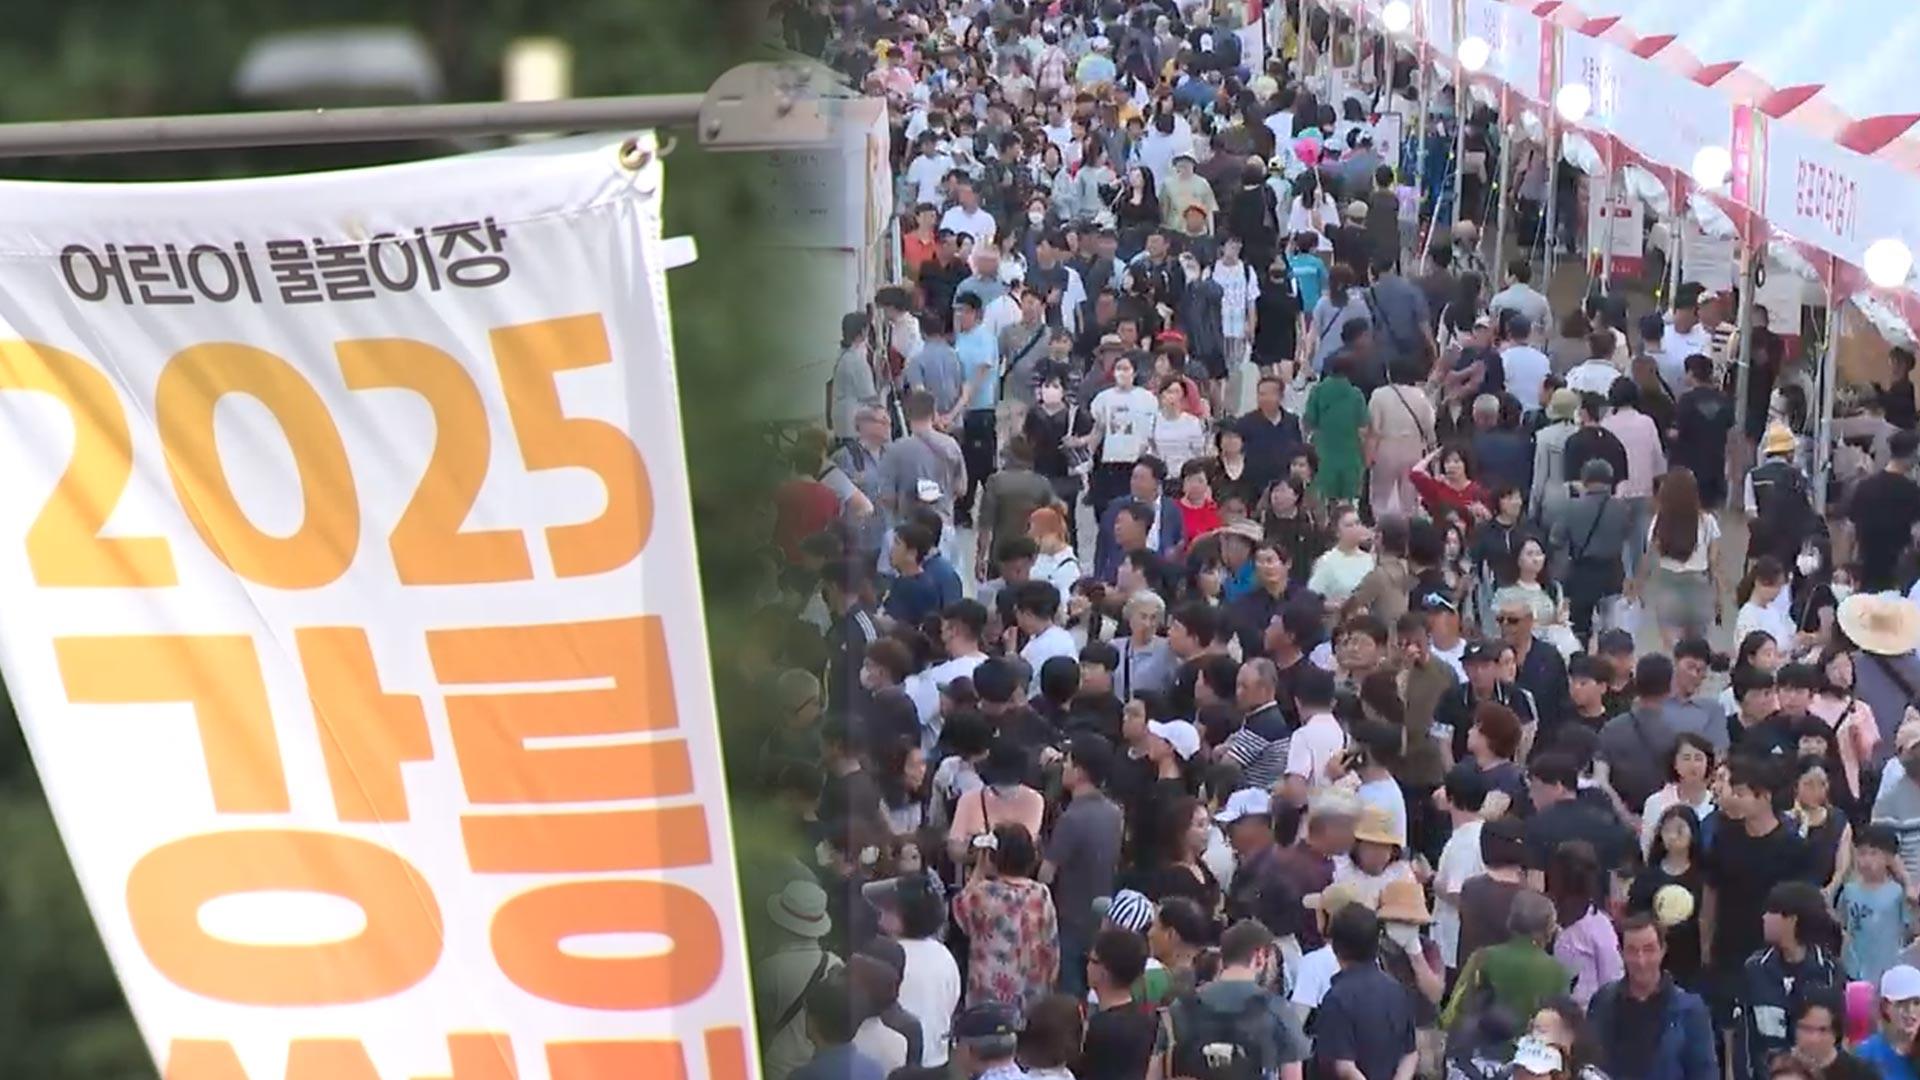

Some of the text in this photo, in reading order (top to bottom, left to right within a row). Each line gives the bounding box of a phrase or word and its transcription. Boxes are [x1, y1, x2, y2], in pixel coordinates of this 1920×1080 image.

[59, 216, 511, 305] 어린이 물놀이장
[0, 312, 655, 590] 2025
[52, 613, 725, 1012] 강릉
